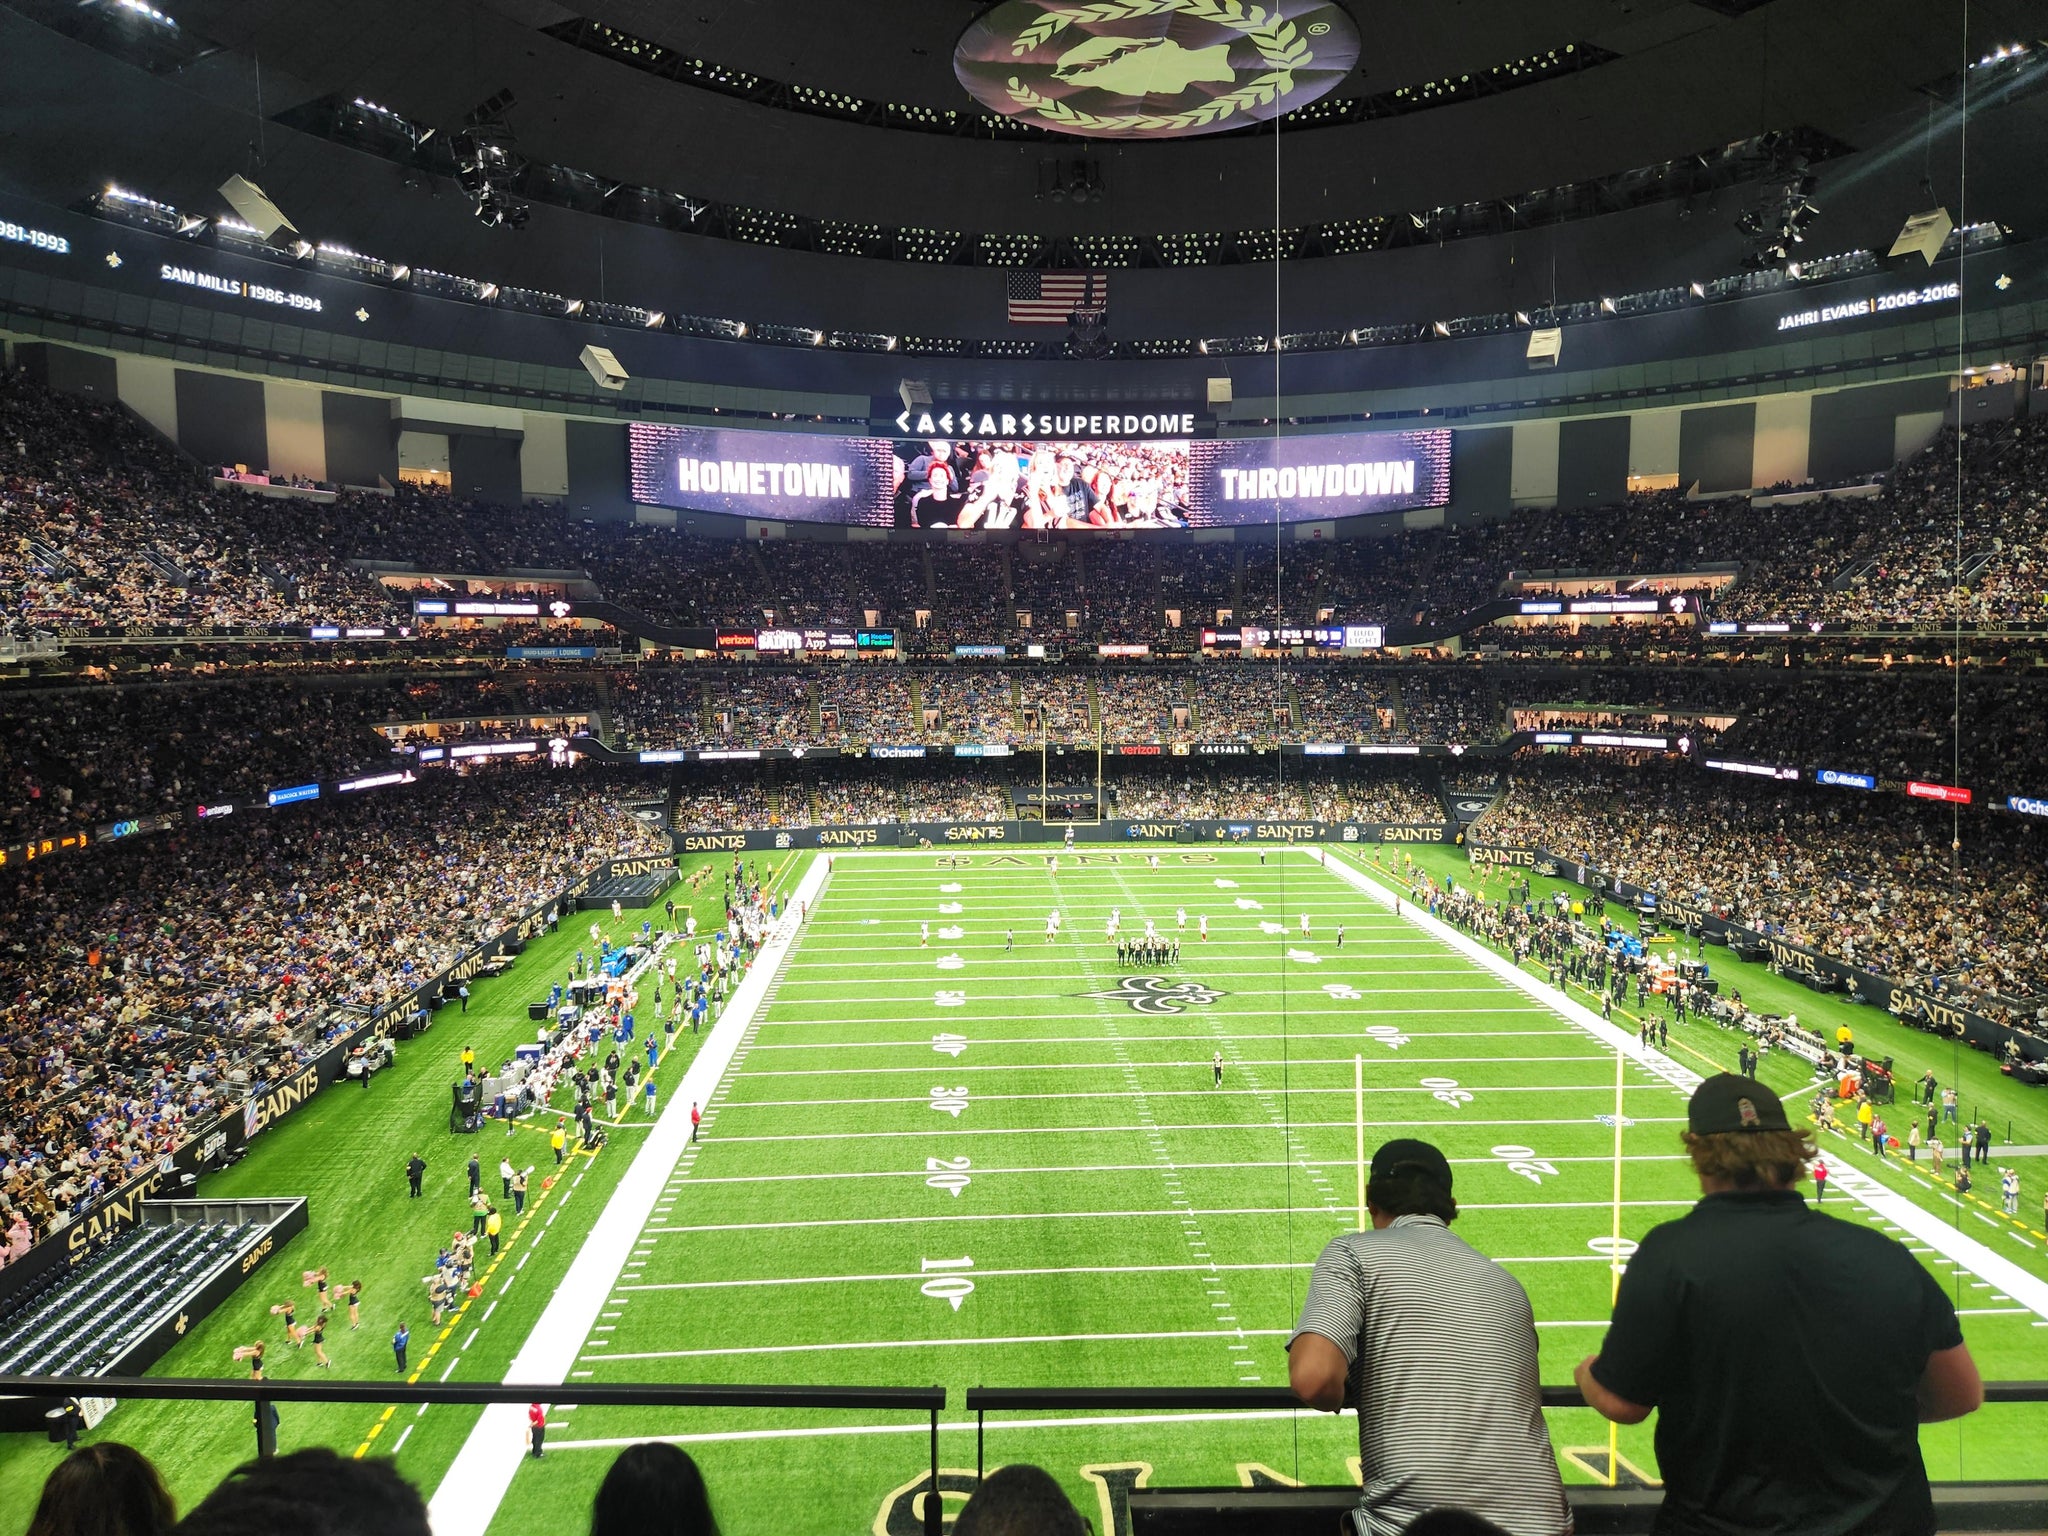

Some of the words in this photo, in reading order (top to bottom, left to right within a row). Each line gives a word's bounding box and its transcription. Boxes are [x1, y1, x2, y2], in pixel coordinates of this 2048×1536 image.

[161, 264, 197, 286] SAM
[198, 271, 241, 295] MILLS
[249, 285, 322, 312] 1986-1994
[1778, 310, 1819, 331] JAHRI
[1822, 301, 1870, 321] EVANS
[1877, 283, 1960, 311] 2006-2016
[896, 411, 1036, 436] CAESARS
[1040, 413, 1196, 436] SUPERDOME
[678, 458, 850, 499] HOMETOWN
[1221, 460, 1415, 500] THROWDOWN
[59, 627, 90, 637] SAINTS
[125, 627, 154, 637] SAINTS
[186, 627, 213, 636] SAINTS
[244, 627, 269, 636] SAINTS
[1850, 623, 1878, 632] SAINTS
[1912, 623, 1941, 632] SAINTS
[1976, 622, 2008, 632] SAINTS
[718, 635, 755, 645] verizon
[805, 638, 827, 650] App
[109, 656, 137, 665] SAINTS
[841, 746, 867, 754] SAINTS
[881, 747, 925, 758] Ochsner
[1120, 746, 1160, 754] verizon
[1200, 745, 1246, 753] CAESARS
[1836, 774, 1867, 787] Allstate
[1878, 779, 1906, 790] SAINTS
[278, 792, 298, 801] HANCOCK
[1027, 793, 1094, 801] SAINTS
[1909, 782, 1948, 799] Community
[155, 811, 182, 824] SAINTS
[113, 819, 139, 837] COX
[1257, 825, 1314, 838] SAINTS
[1384, 827, 1443, 841] SAINTS
[685, 834, 747, 850] SAINTS
[1473, 848, 1535, 866] SAINTS
[1660, 903, 1703, 926] SAINTS
[255, 1065, 319, 1130] SAINTS
[929, 1086, 969, 1111] 30
[1490, 1144, 1559, 1184] 20
[925, 1156, 972, 1188] 20
[242, 1236, 273, 1275] SAINTS
[921, 1256, 975, 1298] 10
